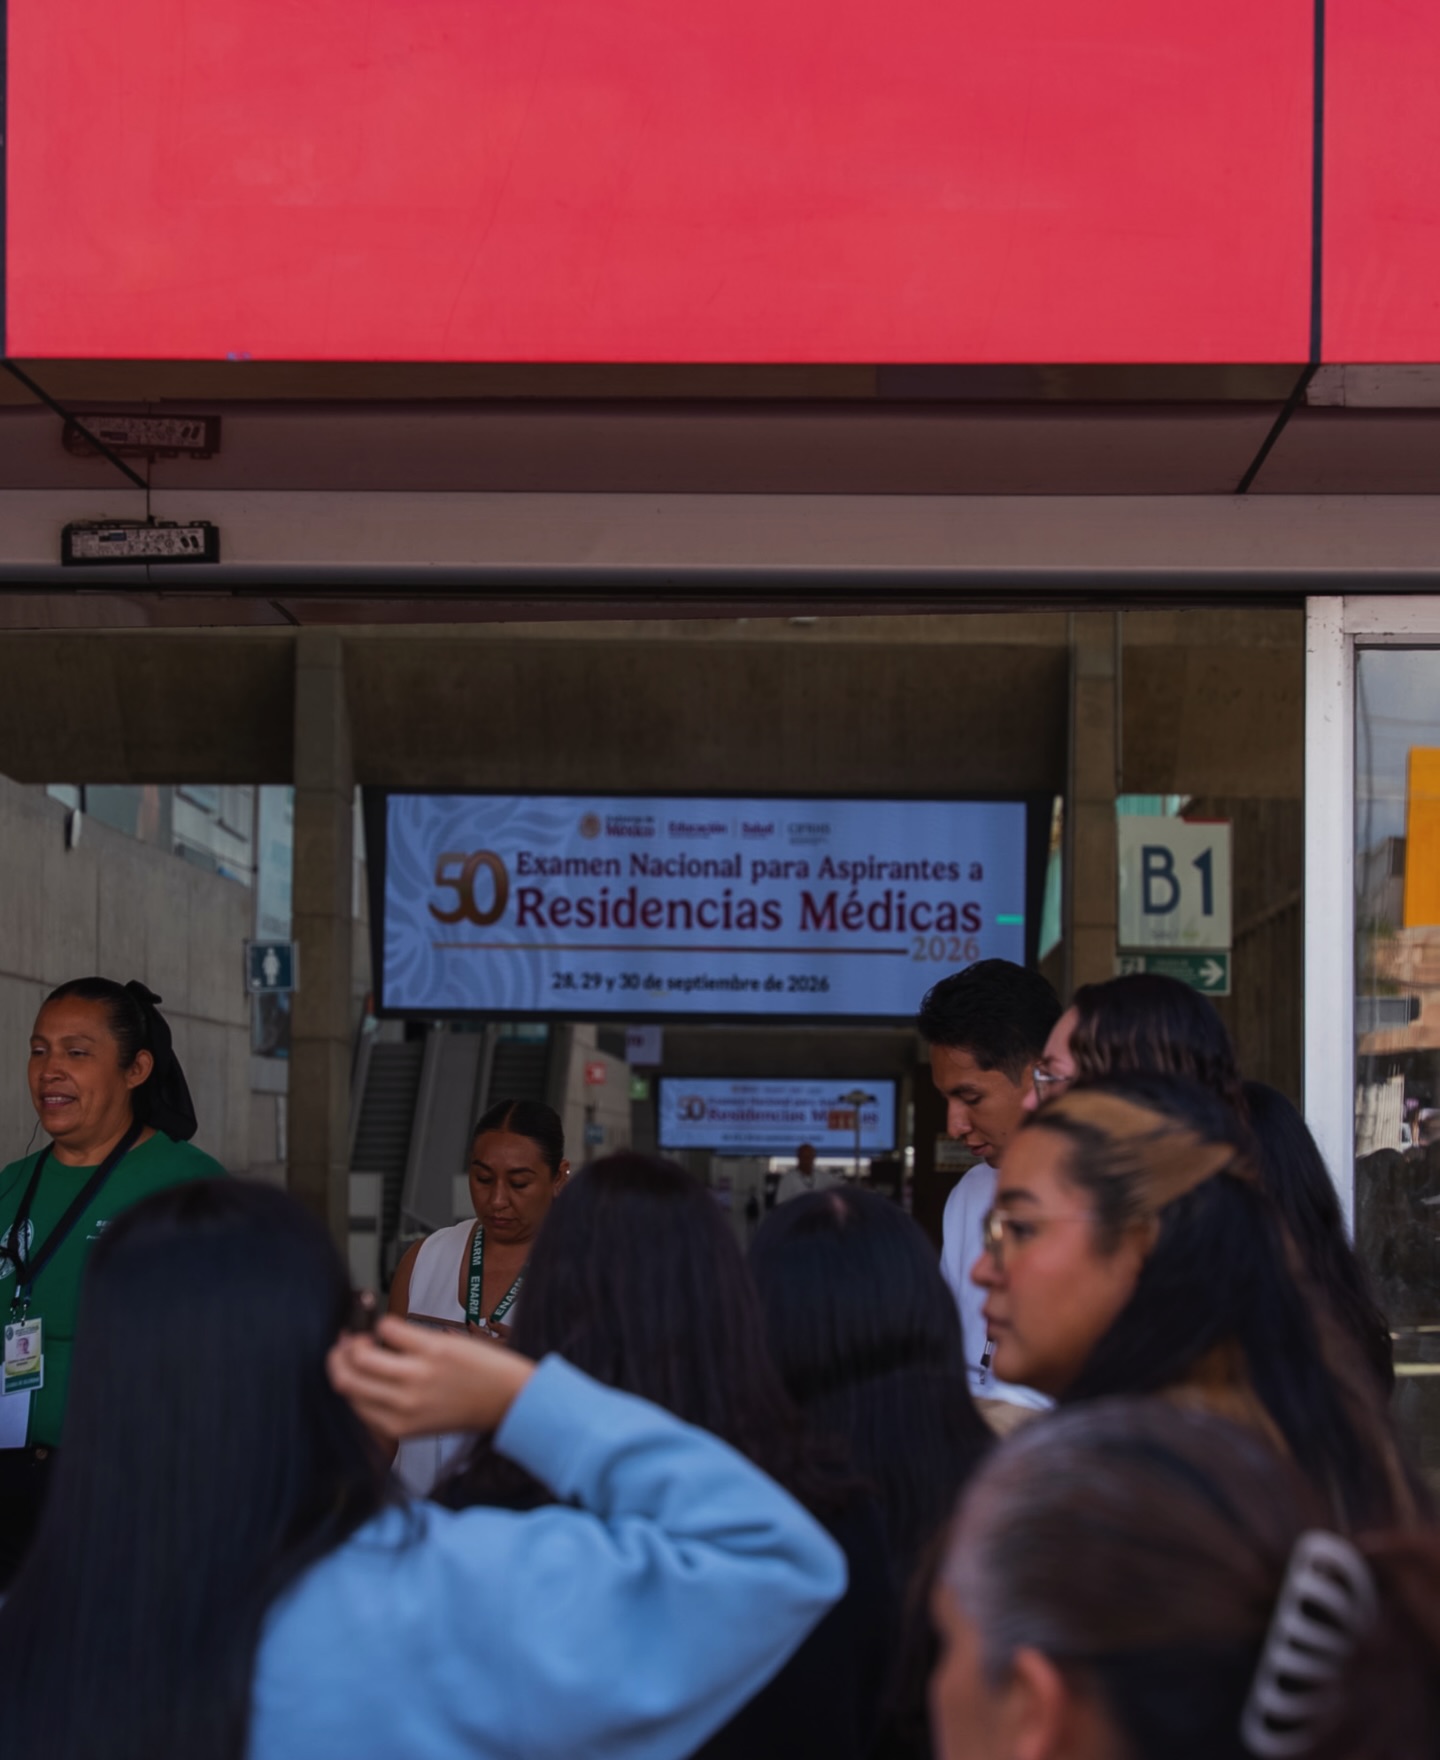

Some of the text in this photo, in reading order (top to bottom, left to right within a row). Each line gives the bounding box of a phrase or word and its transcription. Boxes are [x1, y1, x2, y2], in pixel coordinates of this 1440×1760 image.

[428, 850, 509, 926] 50
[516, 852, 983, 886] Examen Nacional para Aspirantes a
[1142, 845, 1213, 916] B1
[516, 887, 983, 933] Residencias Médicas
[911, 936, 981, 963] 2026
[552, 973, 830, 995] 28, 29 y 30 de septiembre de 2026
[470, 1276, 480, 1315] ENARM
